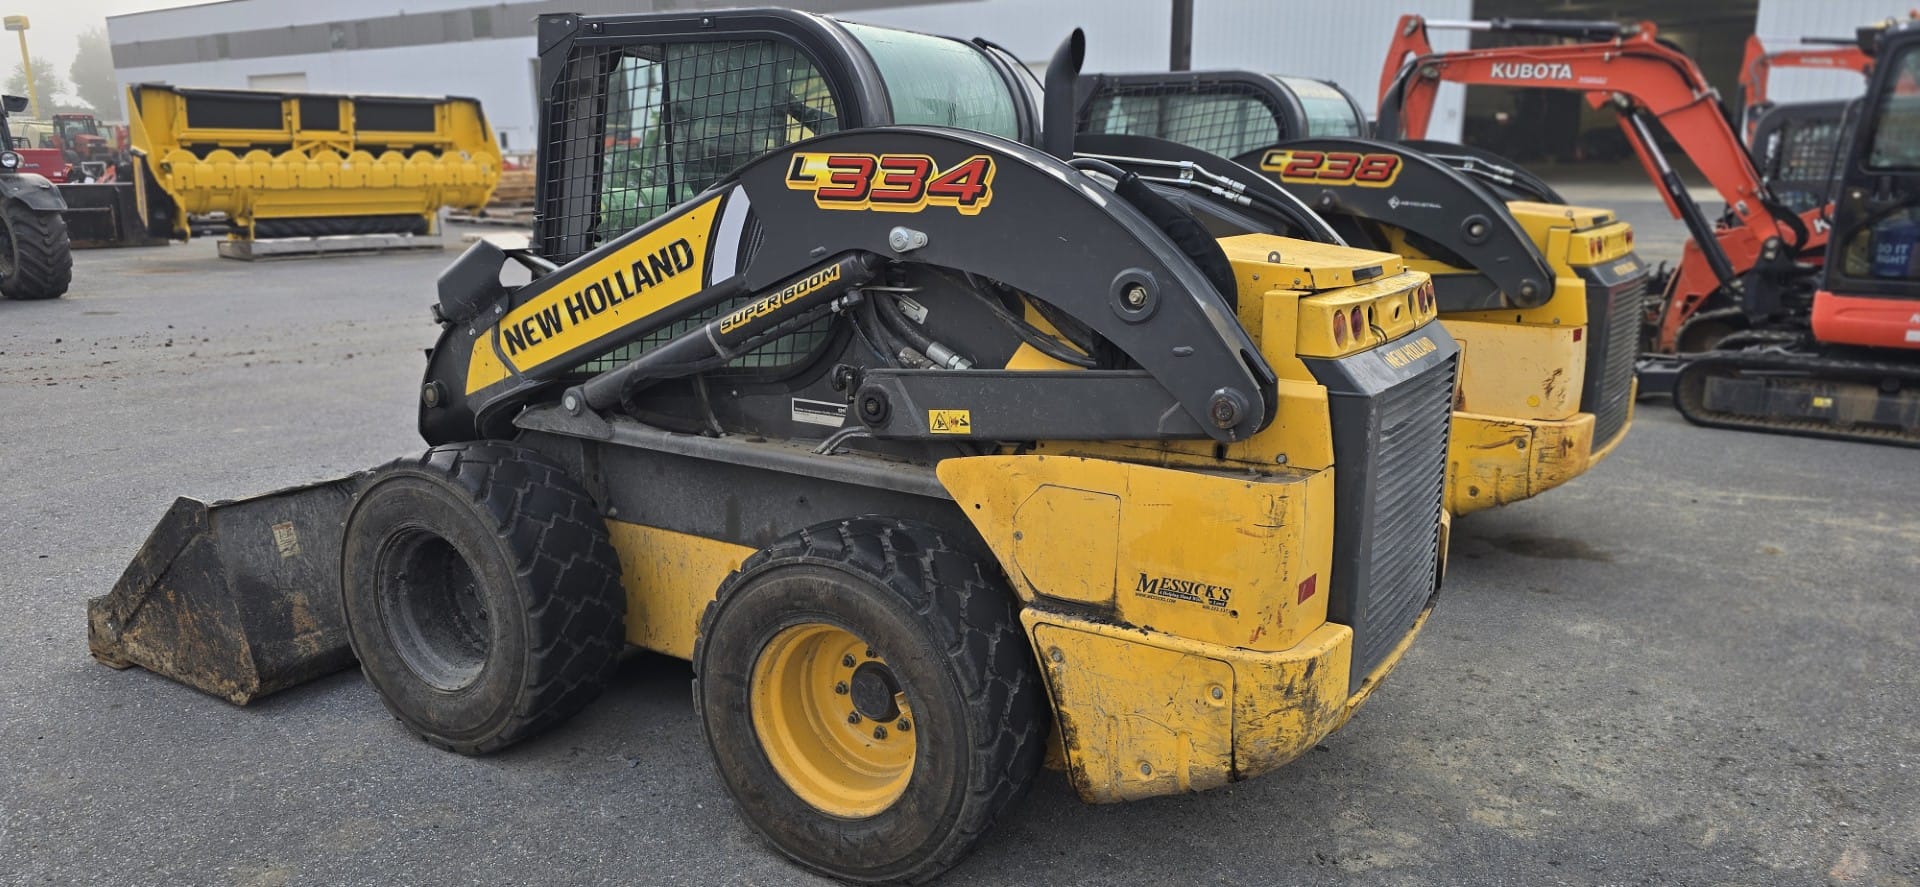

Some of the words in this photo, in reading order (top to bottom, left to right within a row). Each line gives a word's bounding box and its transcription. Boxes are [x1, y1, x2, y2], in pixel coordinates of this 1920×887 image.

[1491, 62, 1573, 80] KUBOTA
[786, 153, 995, 212] L334
[503, 302, 563, 356] NEW
[564, 237, 695, 326] HOLLAND
[721, 293, 780, 333] SUPER
[782, 263, 840, 304] BOOM
[1383, 348, 1410, 369] NEW
[1136, 572, 1232, 602] MESSICK'S
